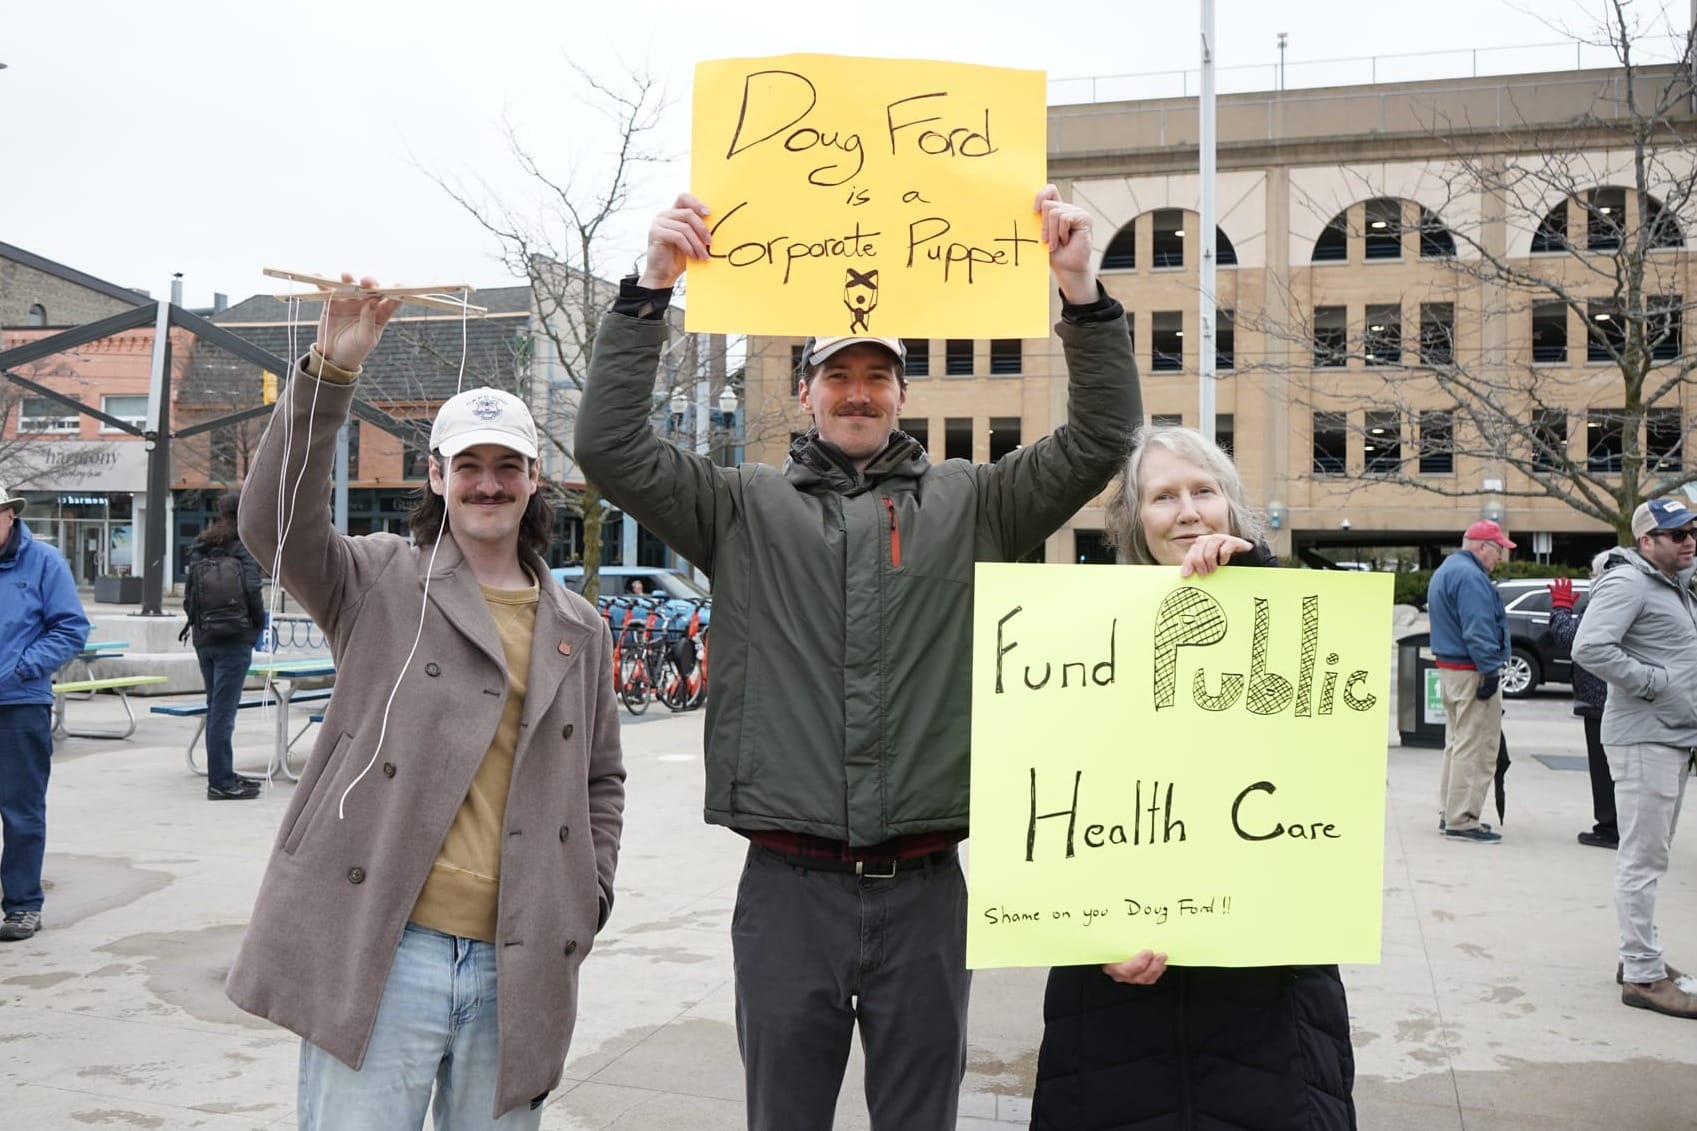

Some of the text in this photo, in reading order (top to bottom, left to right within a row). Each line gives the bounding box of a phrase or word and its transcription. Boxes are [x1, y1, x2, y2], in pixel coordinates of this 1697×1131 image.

[726, 70, 999, 186] Doug Ford
[846, 185, 932, 206] is a
[707, 201, 1039, 285] Corporate Puppet
[995, 586, 1378, 718] Fund Public
[1025, 767, 1342, 862] Health Care
[983, 905, 1041, 925] Shame
[1052, 911, 1072, 921] on
[1083, 908, 1109, 927] you
[1124, 898, 1169, 925] Doug
